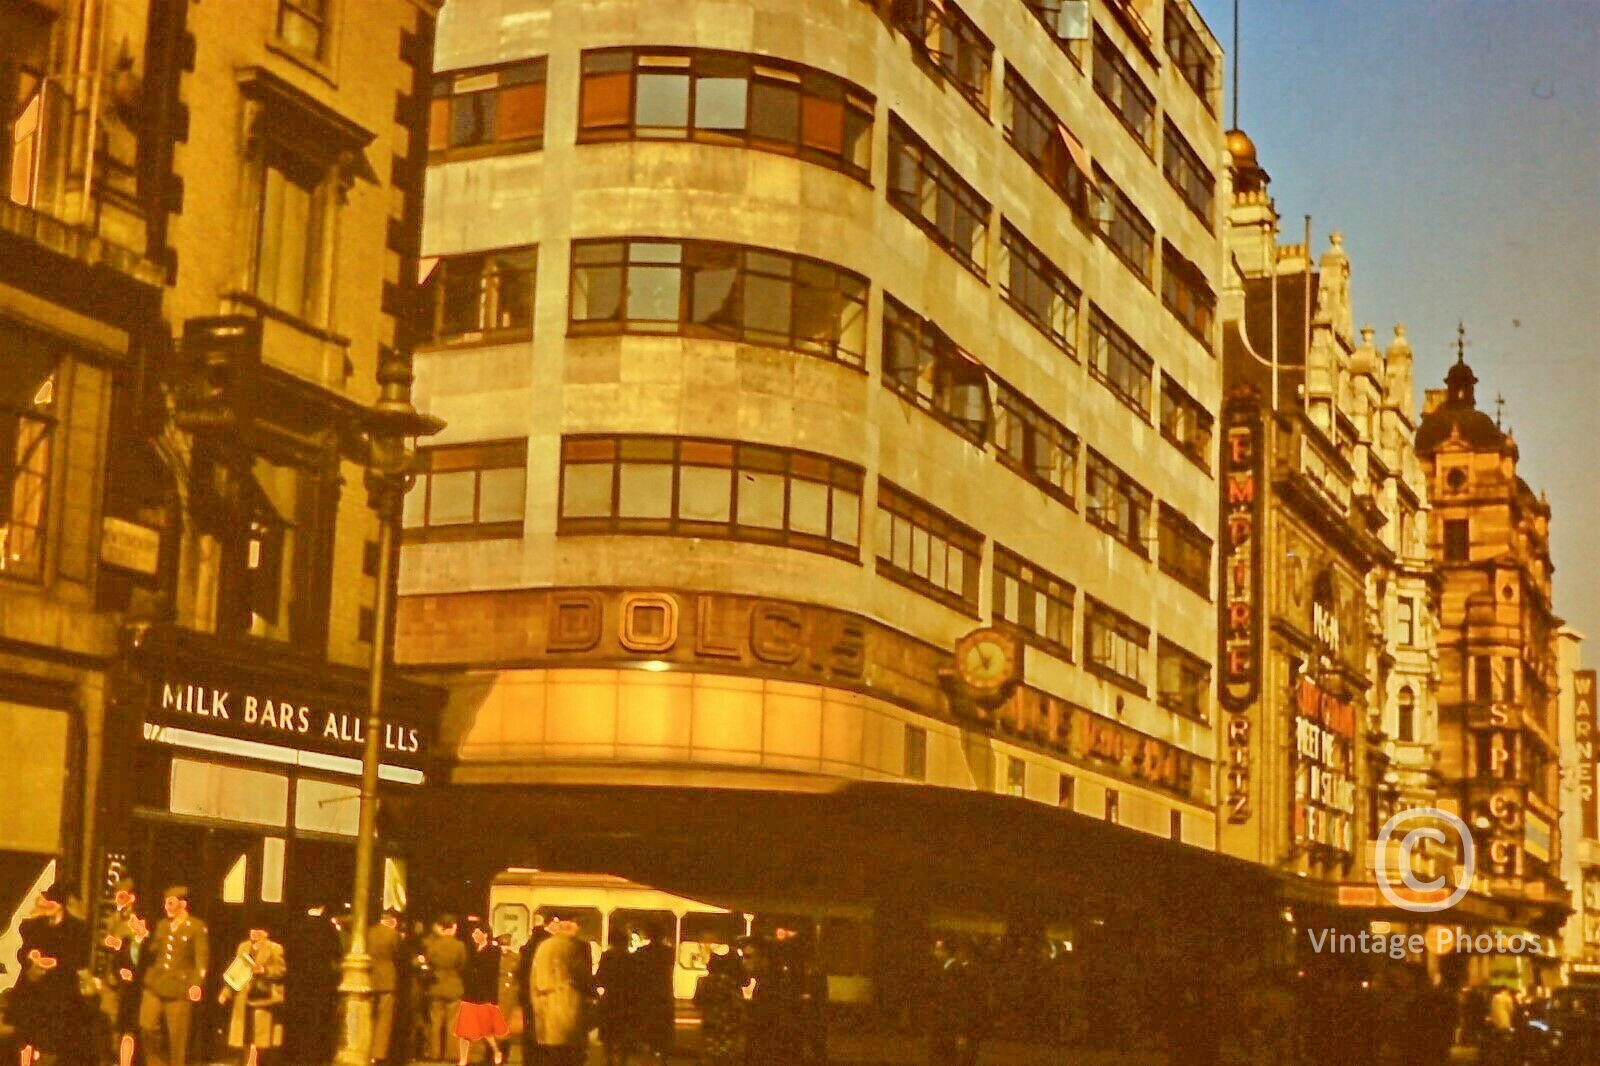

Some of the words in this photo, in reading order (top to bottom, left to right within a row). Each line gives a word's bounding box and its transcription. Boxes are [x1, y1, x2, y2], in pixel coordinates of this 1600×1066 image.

[1227, 427, 1256, 677] EMPIRE
[162, 683, 229, 719] MILK
[244, 695, 309, 733] BARS
[1575, 678, 1593, 801] WARNER
[1227, 718, 1250, 825] RITZ
